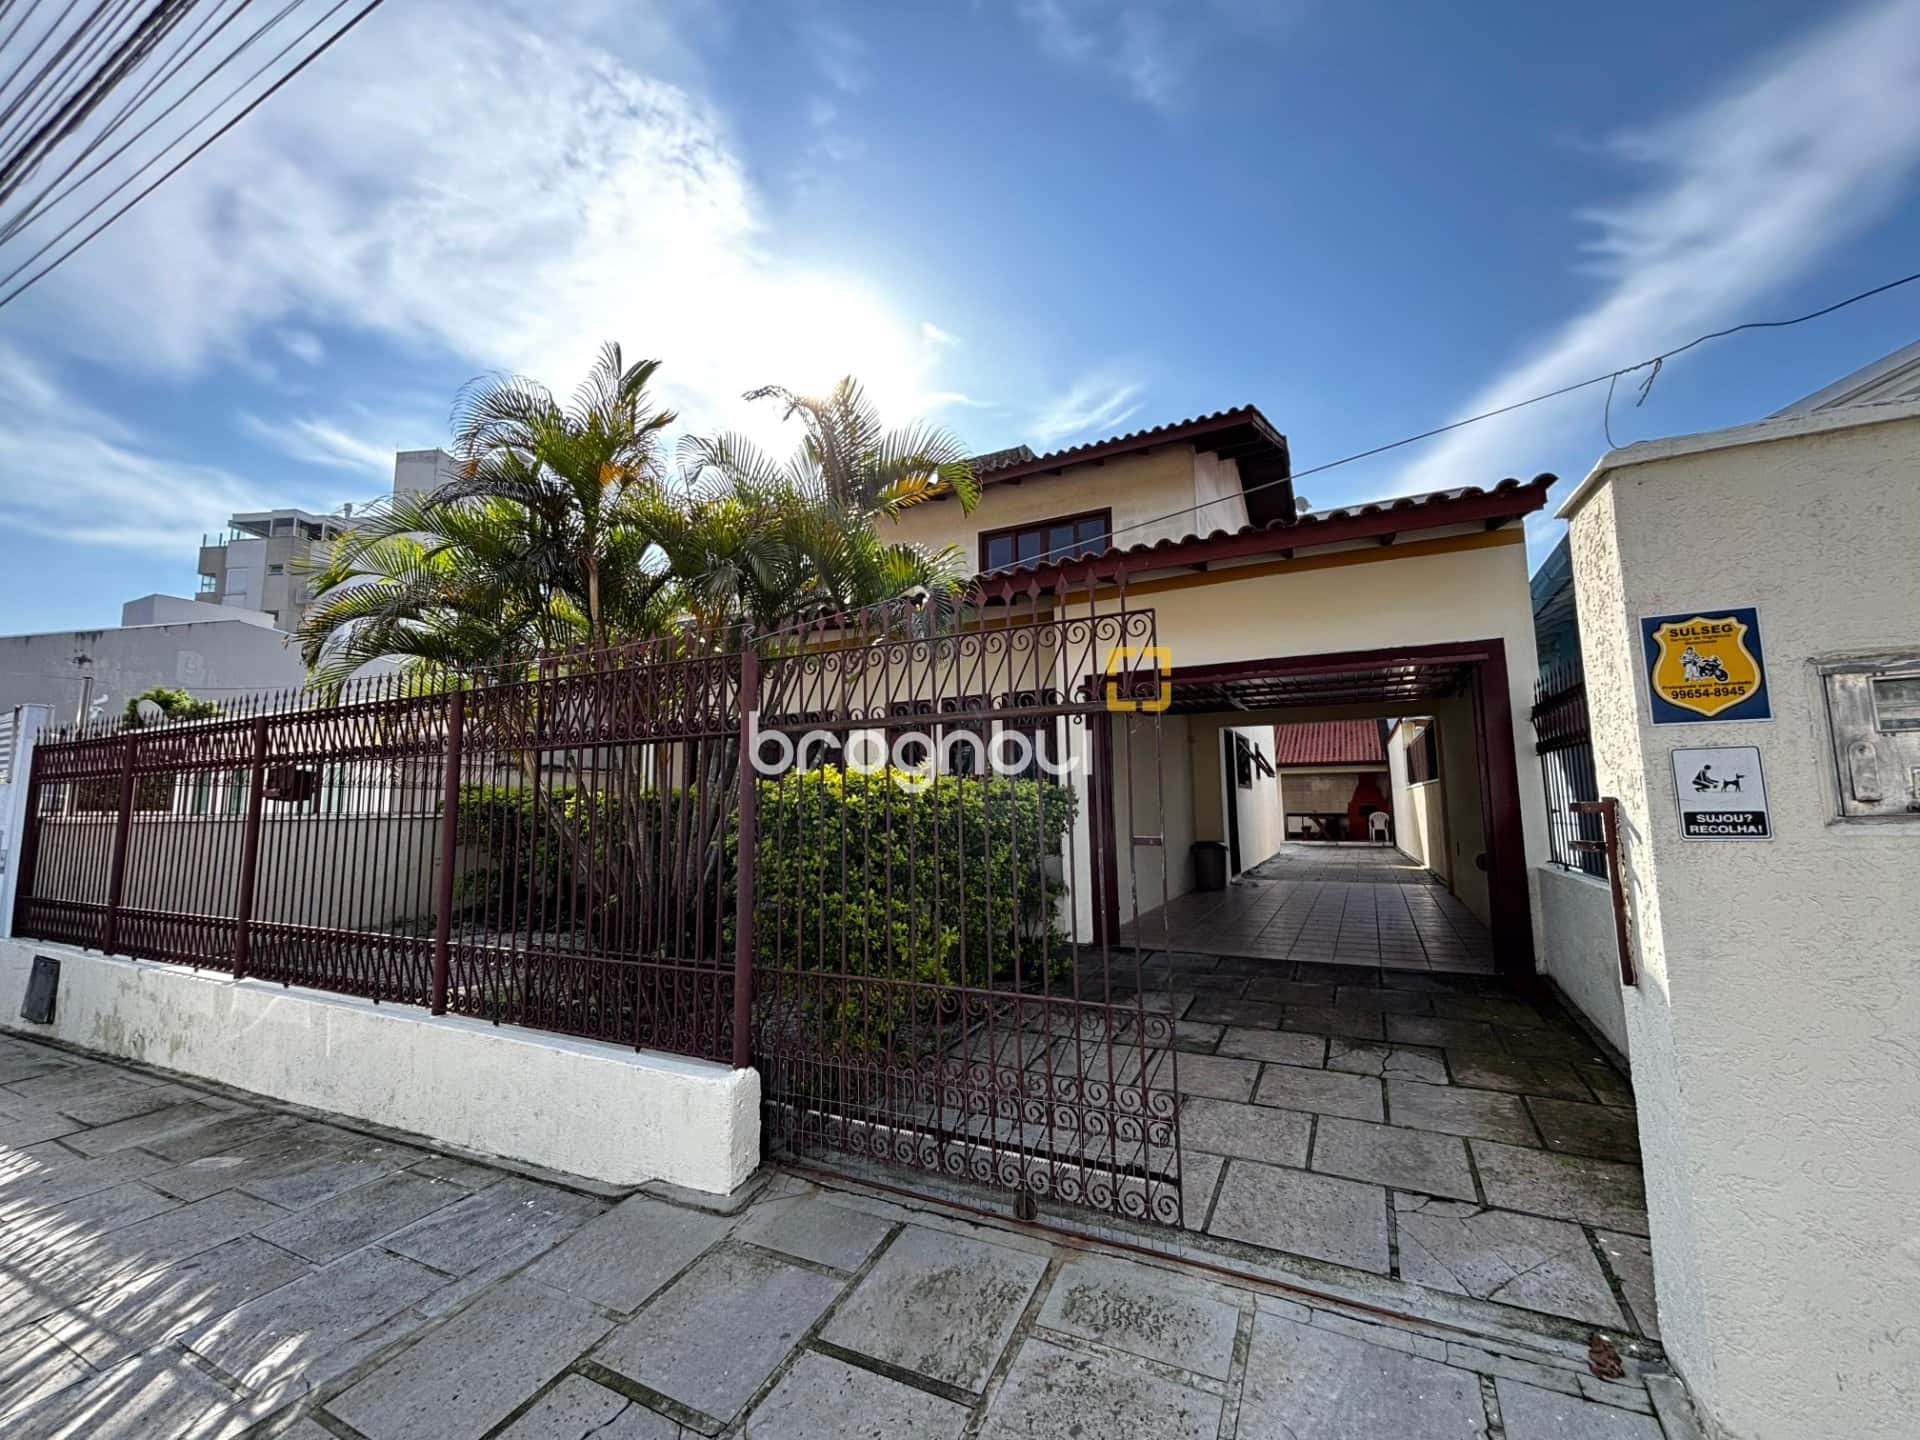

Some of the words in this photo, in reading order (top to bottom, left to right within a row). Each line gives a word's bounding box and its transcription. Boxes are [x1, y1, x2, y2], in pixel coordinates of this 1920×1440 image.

[1669, 624, 1733, 638] SULSEG
[1671, 686, 1746, 700] 99654-8945
[1695, 813, 1753, 823] SUJOU?
[1689, 825, 1763, 834] RECOLHA!
